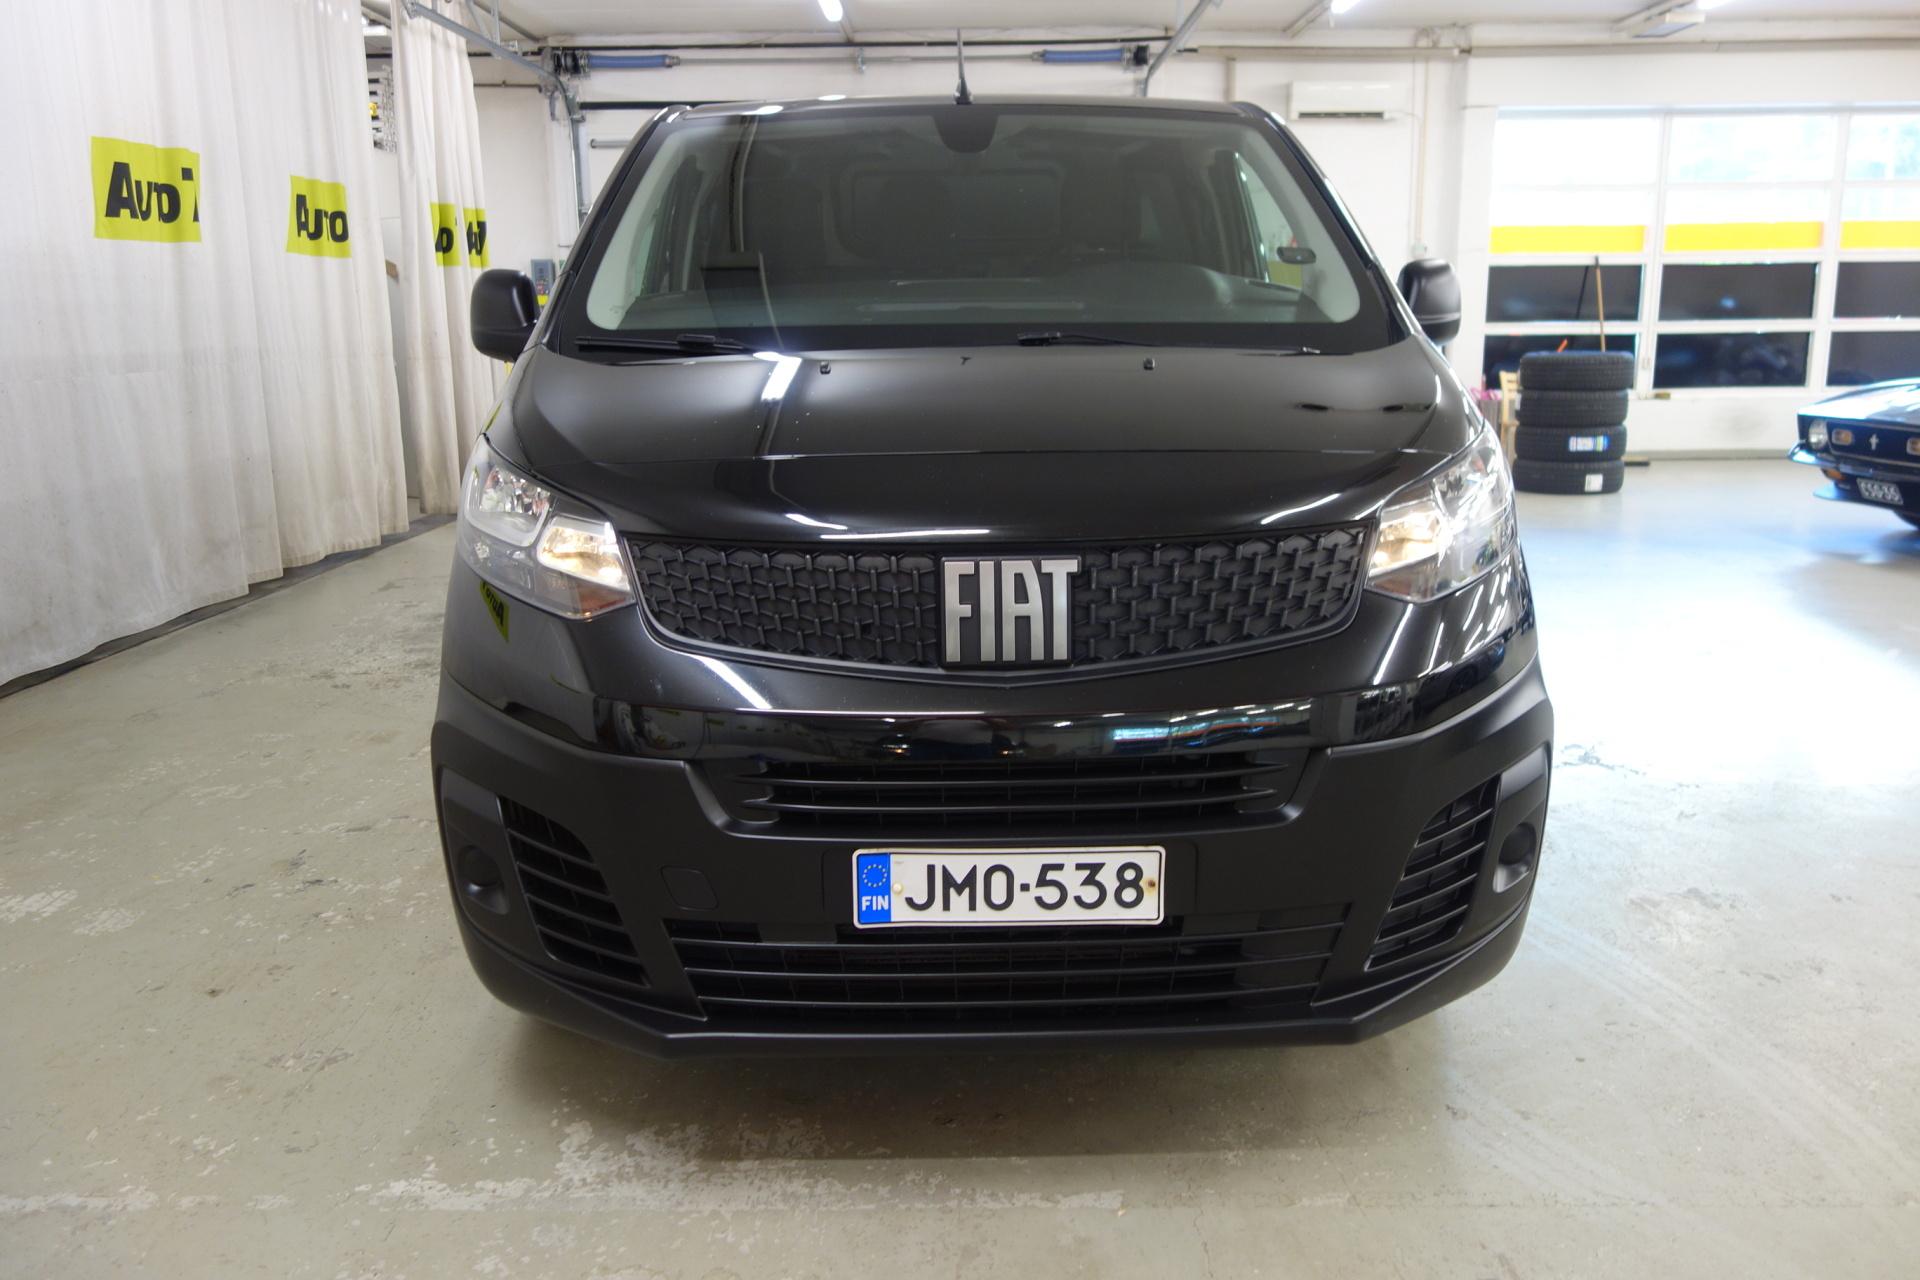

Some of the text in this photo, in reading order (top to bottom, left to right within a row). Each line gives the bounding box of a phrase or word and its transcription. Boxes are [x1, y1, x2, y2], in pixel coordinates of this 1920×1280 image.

[944, 560, 1078, 662] FIAT
[861, 895, 889, 911] FIN
[905, 862, 1144, 912] JMO-538
